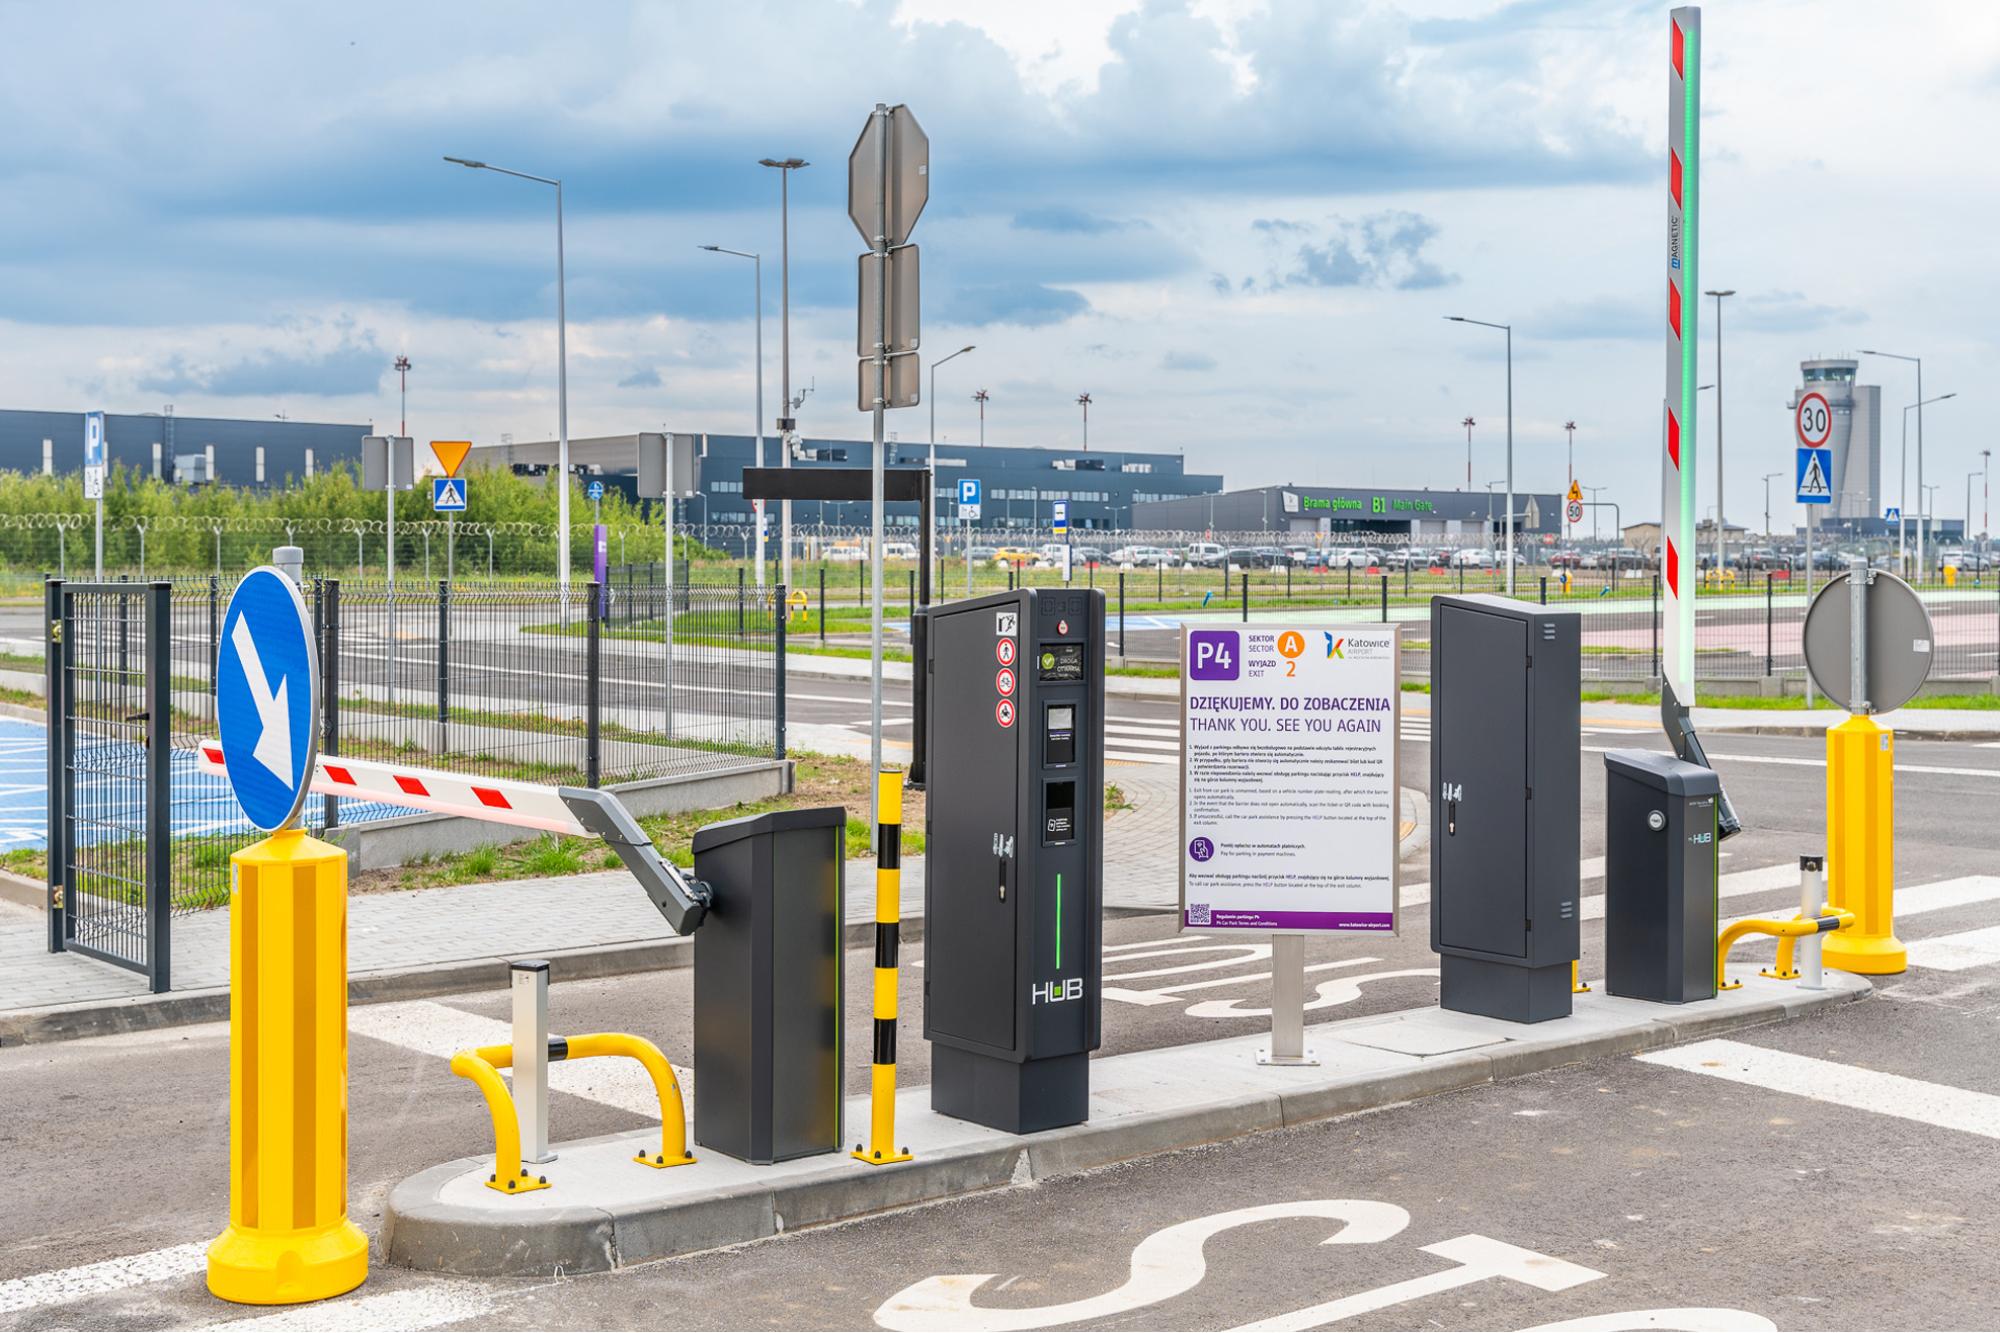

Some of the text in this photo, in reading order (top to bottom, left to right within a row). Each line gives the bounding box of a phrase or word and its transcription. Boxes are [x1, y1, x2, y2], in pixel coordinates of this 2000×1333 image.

[1804, 407, 1826, 432] 30
[88, 416, 100, 460] P
[963, 482, 976, 502] P
[1303, 496, 1433, 513] Brama główna B1 Main Gate
[1569, 505, 1581, 518] 50
[1284, 636, 1298, 652] A
[1348, 638, 1390, 648] Katowice
[1198, 643, 1232, 669] P4
[1286, 661, 1296, 677] 2
[1190, 697, 1390, 712] DZIĘKUJEMY. DO ZOBACZENIA
[1190, 718, 1381, 732] THANK YOU. SEE YOU AGAIN
[1693, 832, 1711, 844] HUB
[1032, 977, 1083, 1005] HUB
